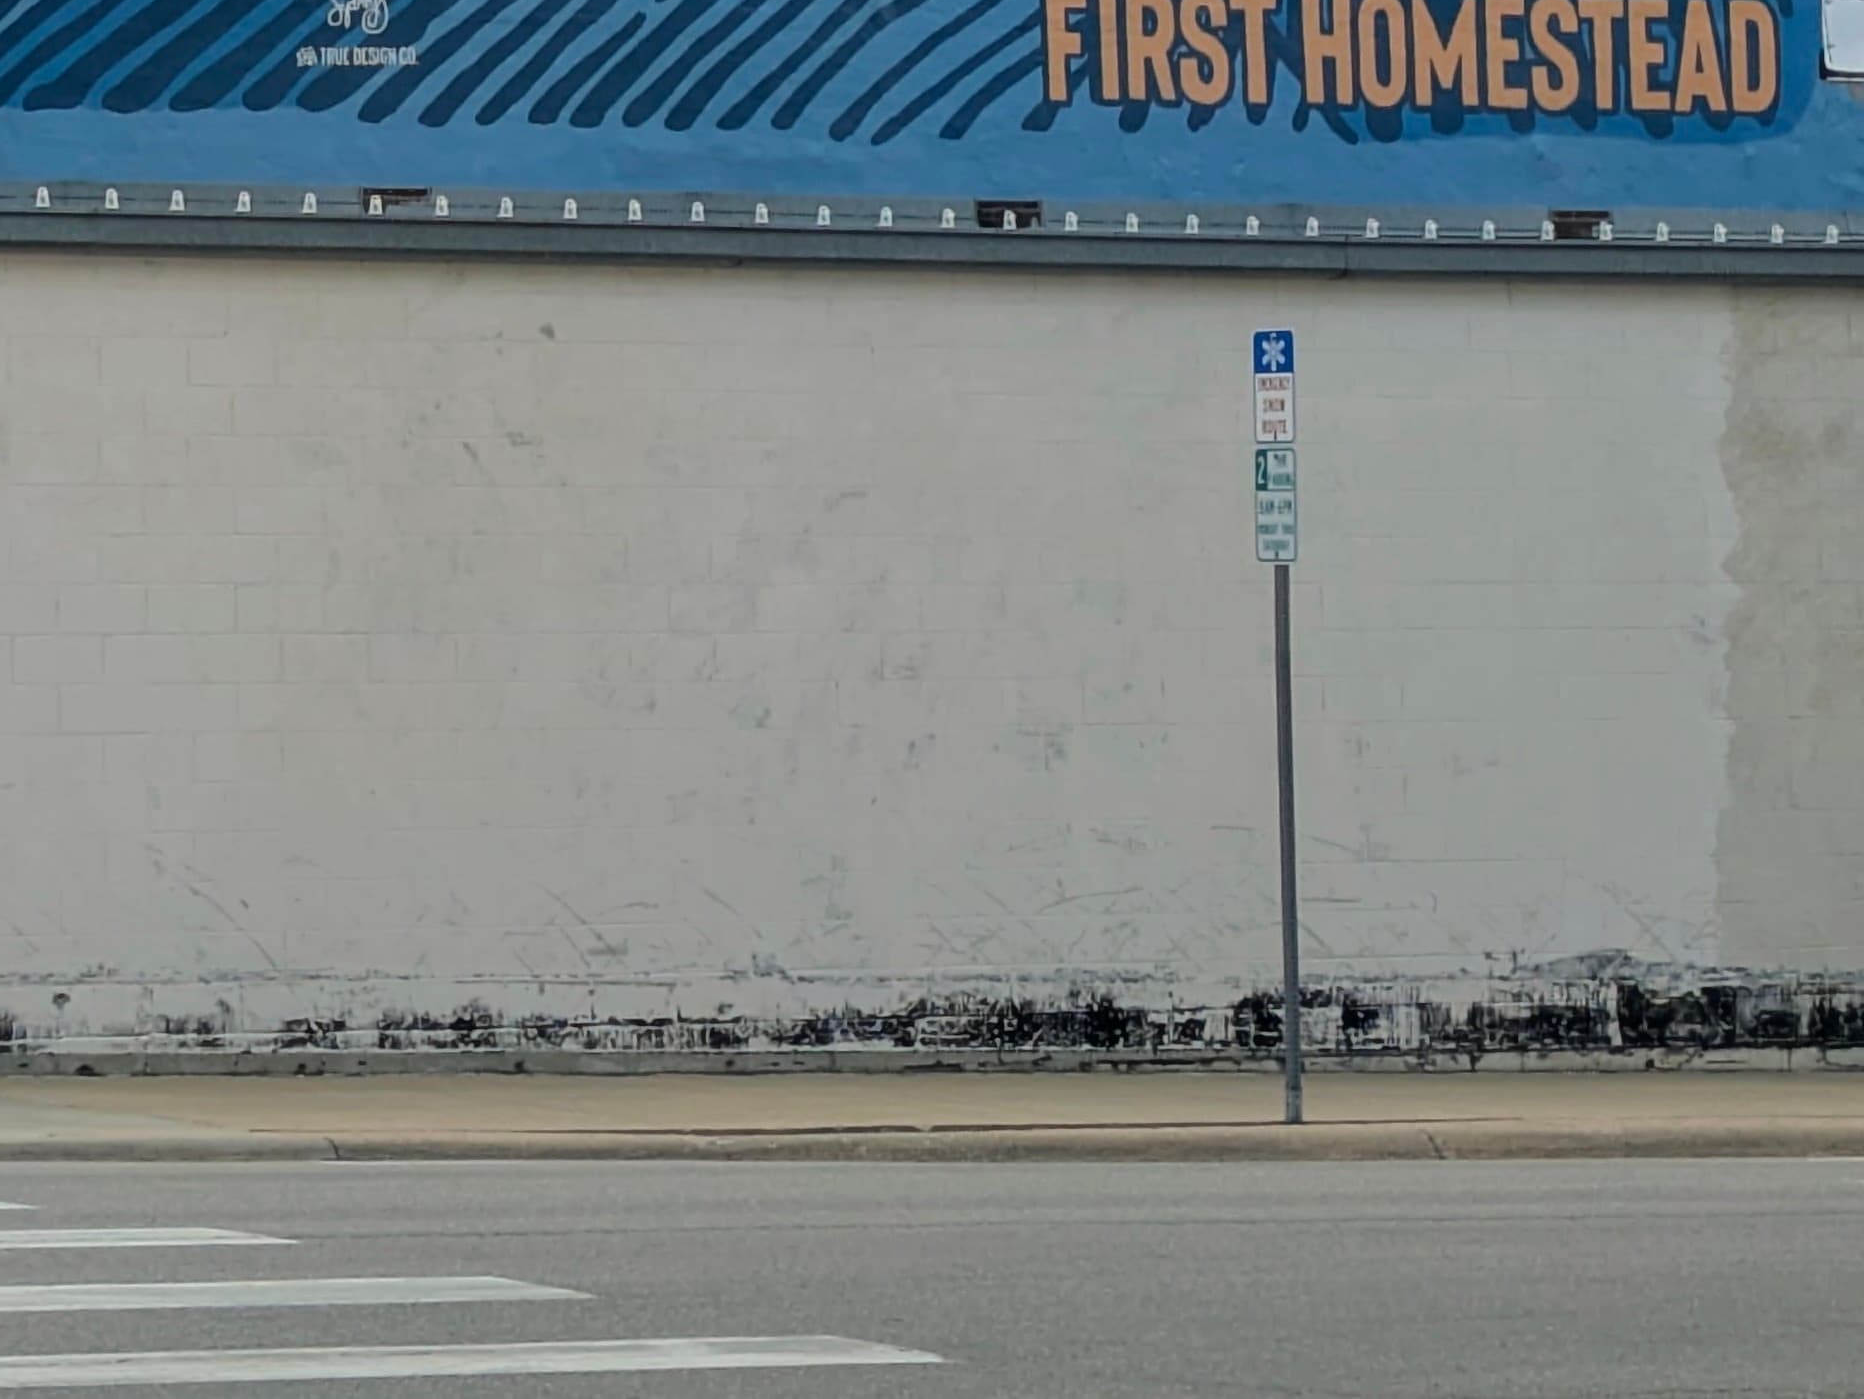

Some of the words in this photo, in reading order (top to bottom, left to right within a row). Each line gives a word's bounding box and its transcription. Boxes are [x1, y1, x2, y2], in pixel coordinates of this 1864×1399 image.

[320, 46, 350, 66] TRUE
[353, 46, 397, 66] DESIGN
[1257, 455, 1265, 484] 2
